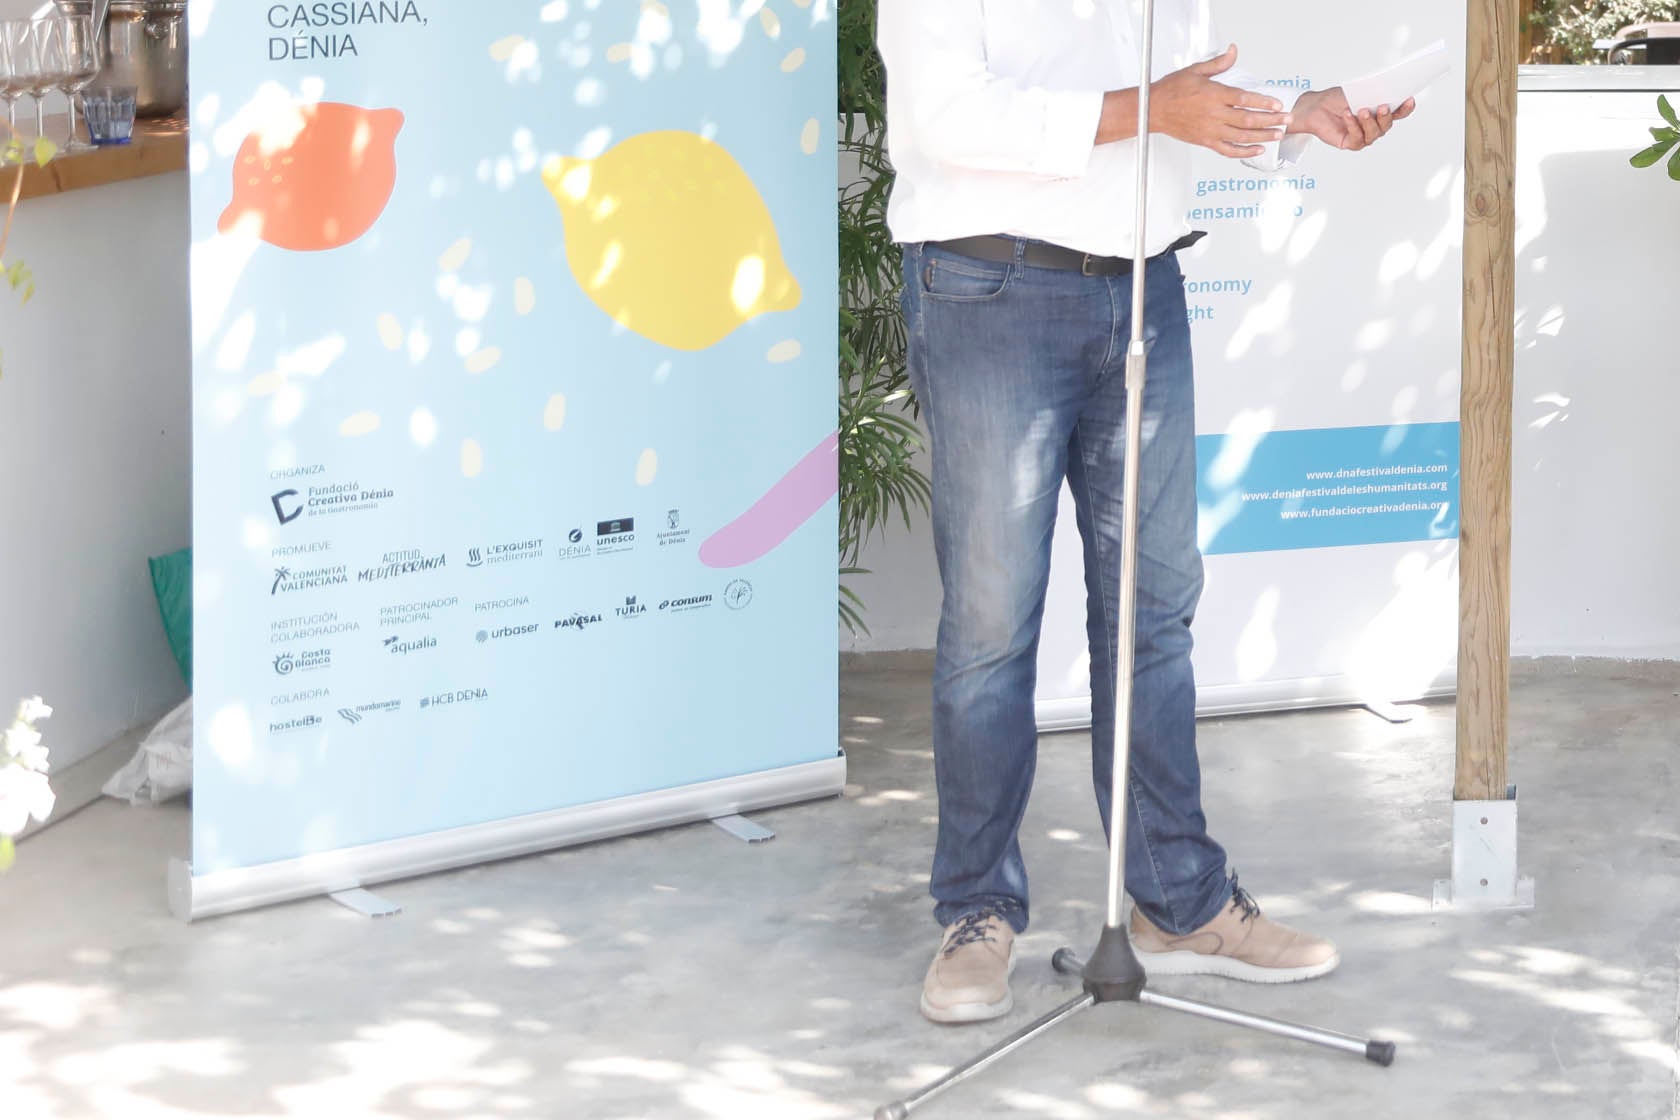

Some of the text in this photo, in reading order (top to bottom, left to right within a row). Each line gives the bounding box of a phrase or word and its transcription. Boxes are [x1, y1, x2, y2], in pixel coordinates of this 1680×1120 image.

[267, 0, 428, 28] CASSIANA,
[268, 30, 358, 61] DÉNIA
[270, 464, 326, 481] ORGANIZA
[1306, 463, 1448, 481] www.dnafestivaldenia.com
[308, 480, 360, 497] Fundació
[308, 488, 394, 507] Creativa Dénia
[487, 539, 543, 556] L'EXQUISIT
[597, 534, 635, 546] unesco
[271, 540, 332, 558] PROMUEVE
[382, 549, 421, 564] ACTITUD
[292, 565, 347, 581] COMUNITAT
[280, 575, 348, 593] VALENCIANA
[380, 596, 458, 616] PATROCINADOR
[474, 596, 529, 613] PATROCINA
[671, 594, 712, 607] consum
[615, 604, 647, 617] TURIA
[271, 611, 338, 631] INSTITUCIÓN
[380, 612, 432, 627] PRINCIPAL
[554, 613, 603, 629] PAVASAL
[270, 621, 360, 643] COLABORADORA
[491, 622, 539, 639] urbaser
[391, 637, 437, 654] aqualia
[271, 687, 330, 706] COLABORA
[432, 692, 454, 706] HCB
